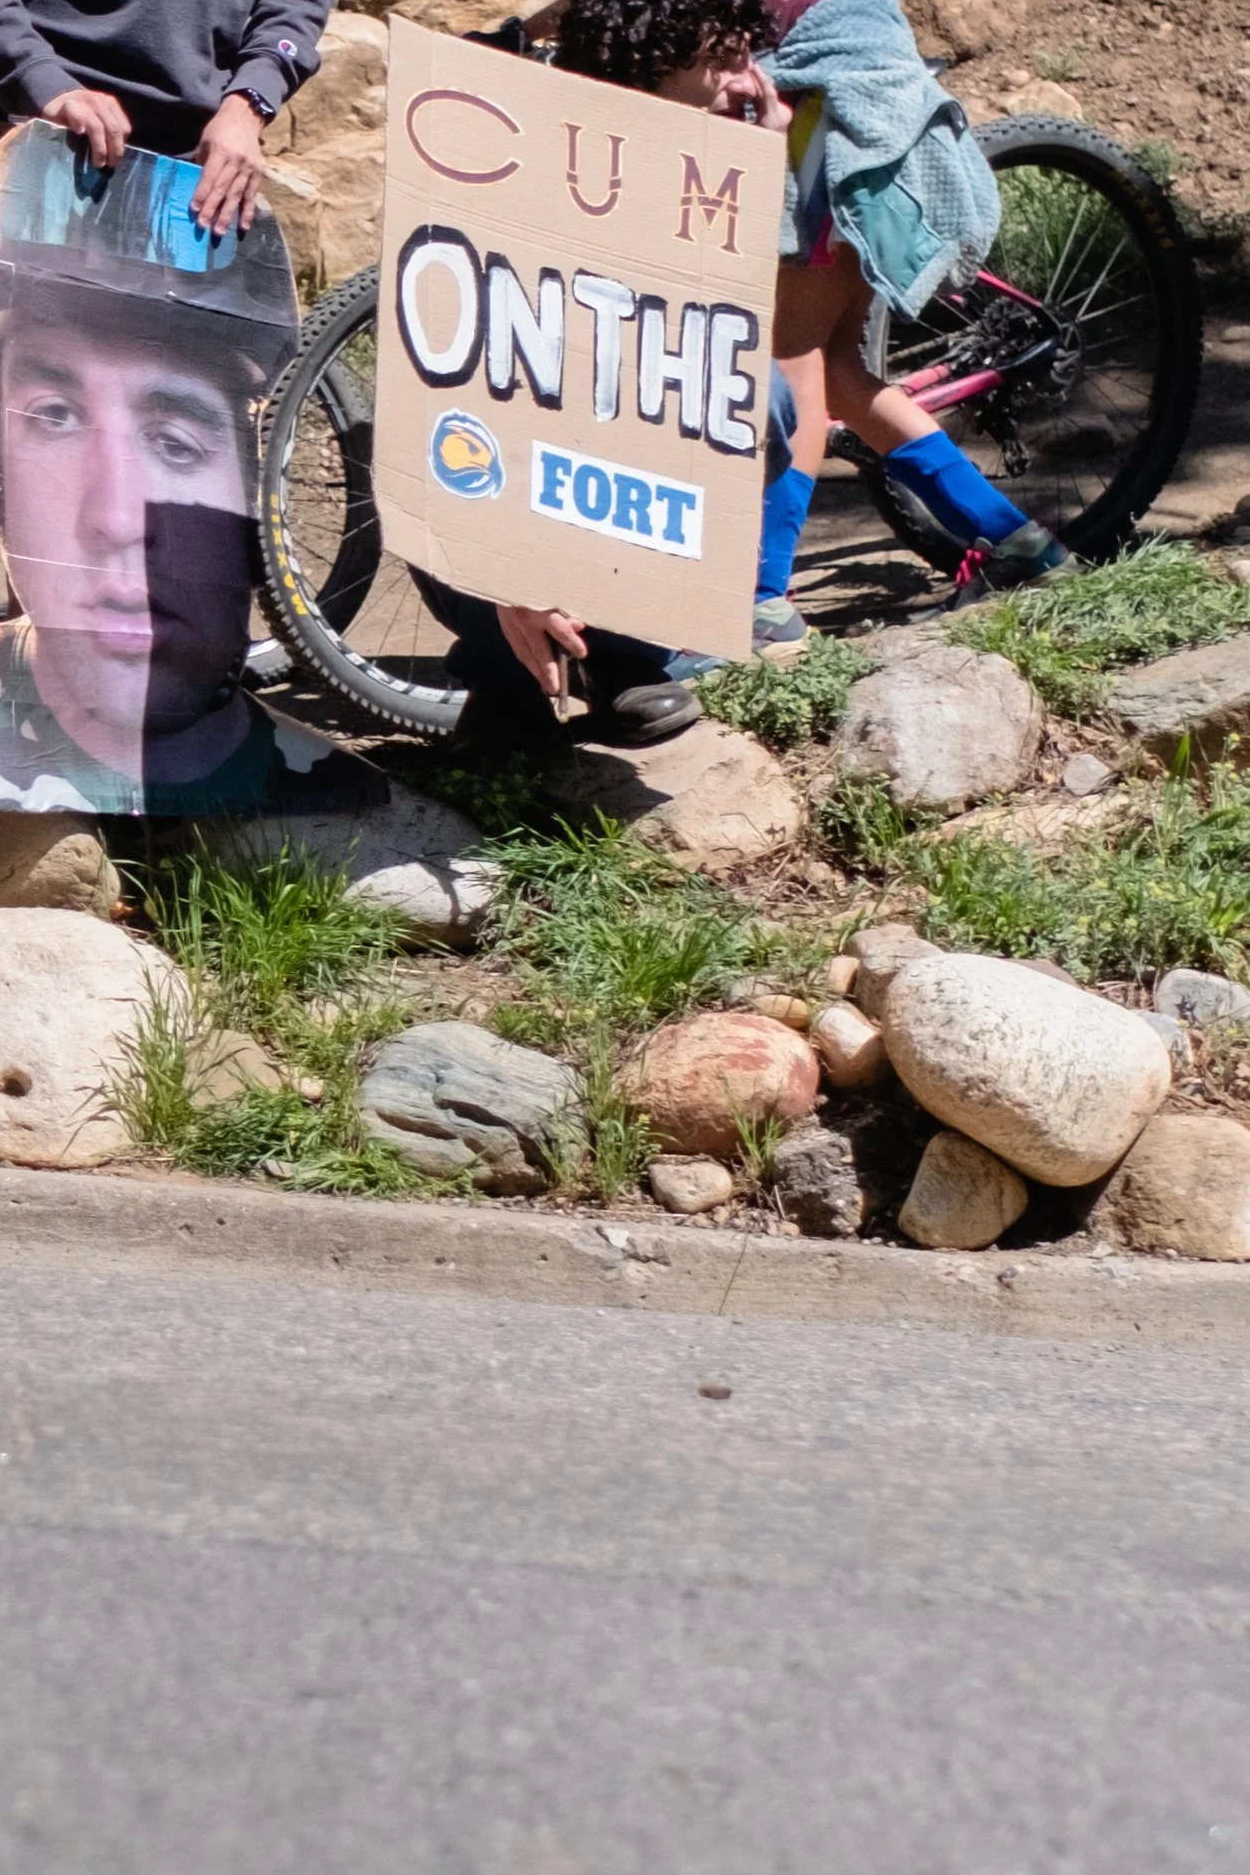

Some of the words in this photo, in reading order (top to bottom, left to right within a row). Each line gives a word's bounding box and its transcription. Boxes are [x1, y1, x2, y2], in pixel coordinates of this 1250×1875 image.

[405, 87, 746, 256] CUM
[396, 224, 564, 411] ON
[570, 267, 759, 458] THE
[538, 449, 696, 545] FORT
